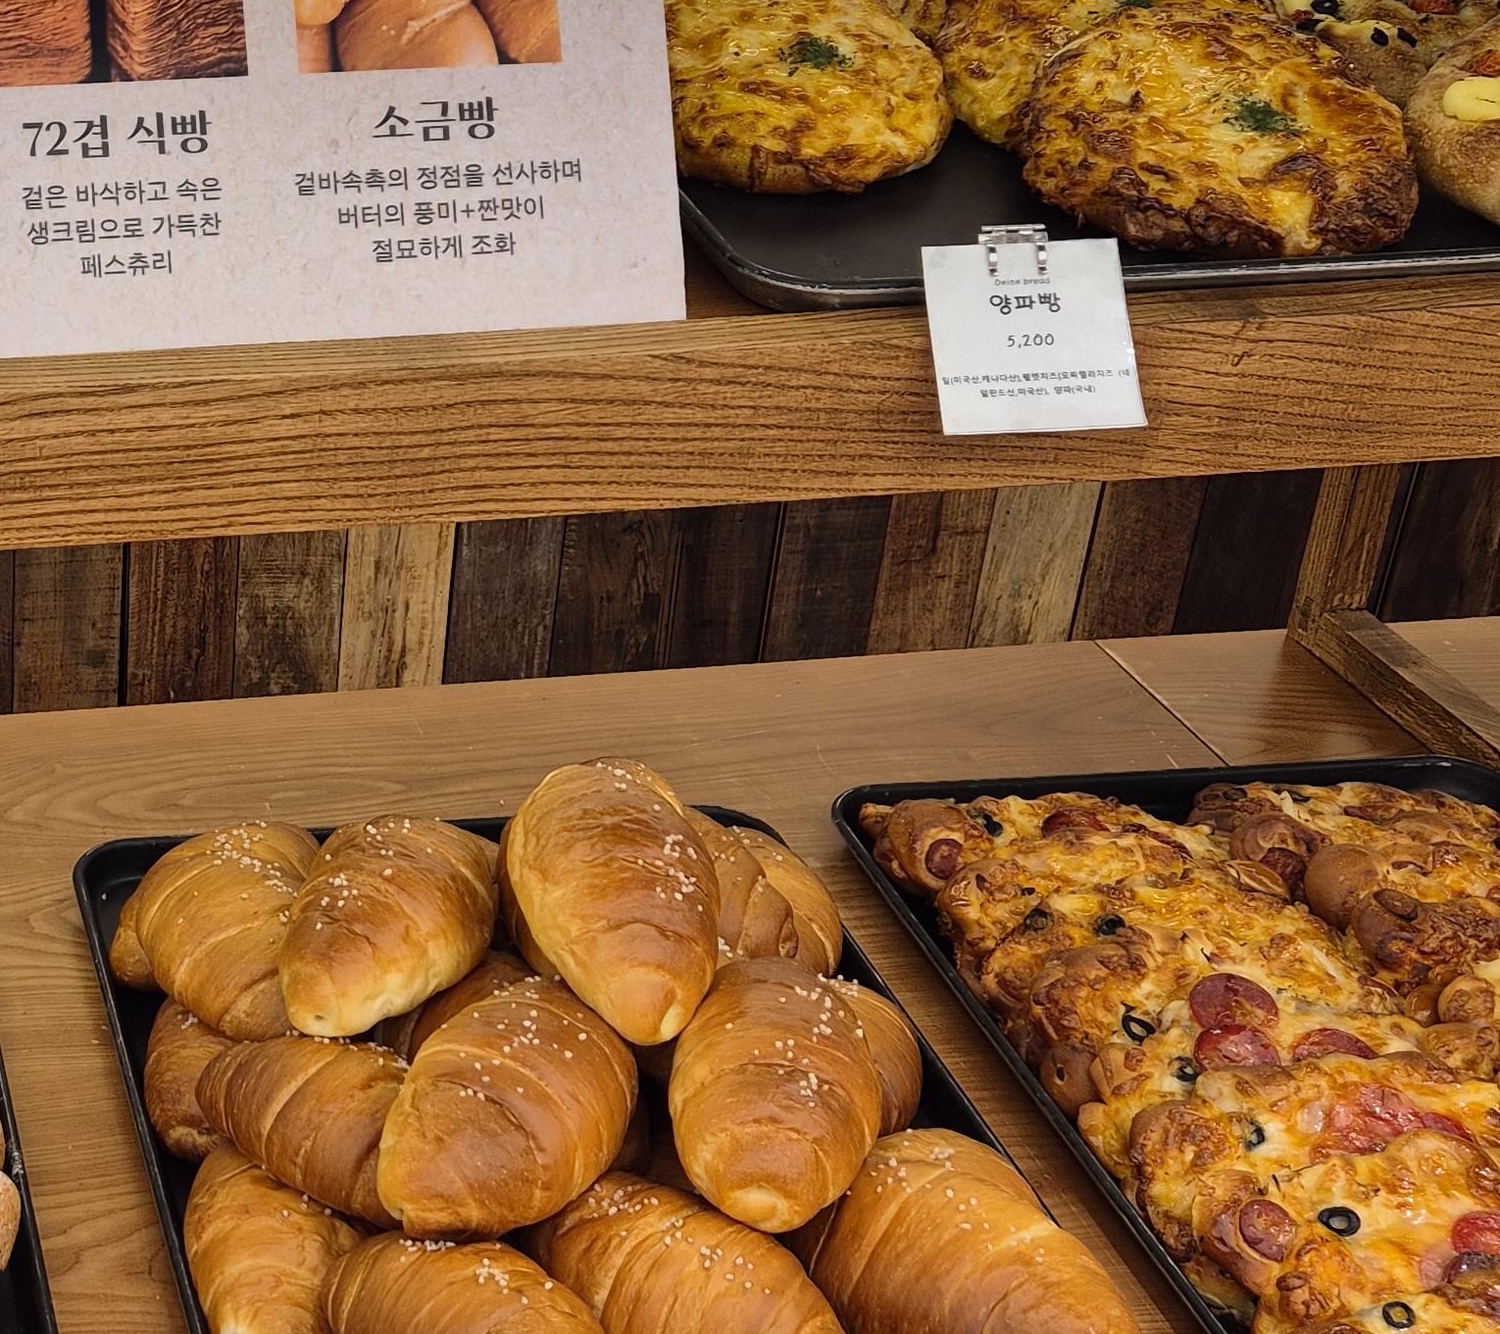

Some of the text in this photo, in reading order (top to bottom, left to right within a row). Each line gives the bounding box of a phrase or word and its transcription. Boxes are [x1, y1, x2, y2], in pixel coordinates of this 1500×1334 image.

[21, 109, 213, 159] 72겹 식빵
[371, 96, 500, 142] 소금빵
[21, 176, 223, 211] 겉은 바삭하고 속은
[293, 157, 584, 197] 겉바속촉의 정점을 선사하며
[26, 211, 223, 246] 생크림으로 가득찬
[337, 194, 546, 230] 버터의 풍미+짠맛이
[79, 249, 173, 279] 페스츄리
[371, 231, 517, 264] 절묘하게 조화
[988, 291, 1062, 316] 양파빵
[1006, 332, 1055, 349] 5,200
